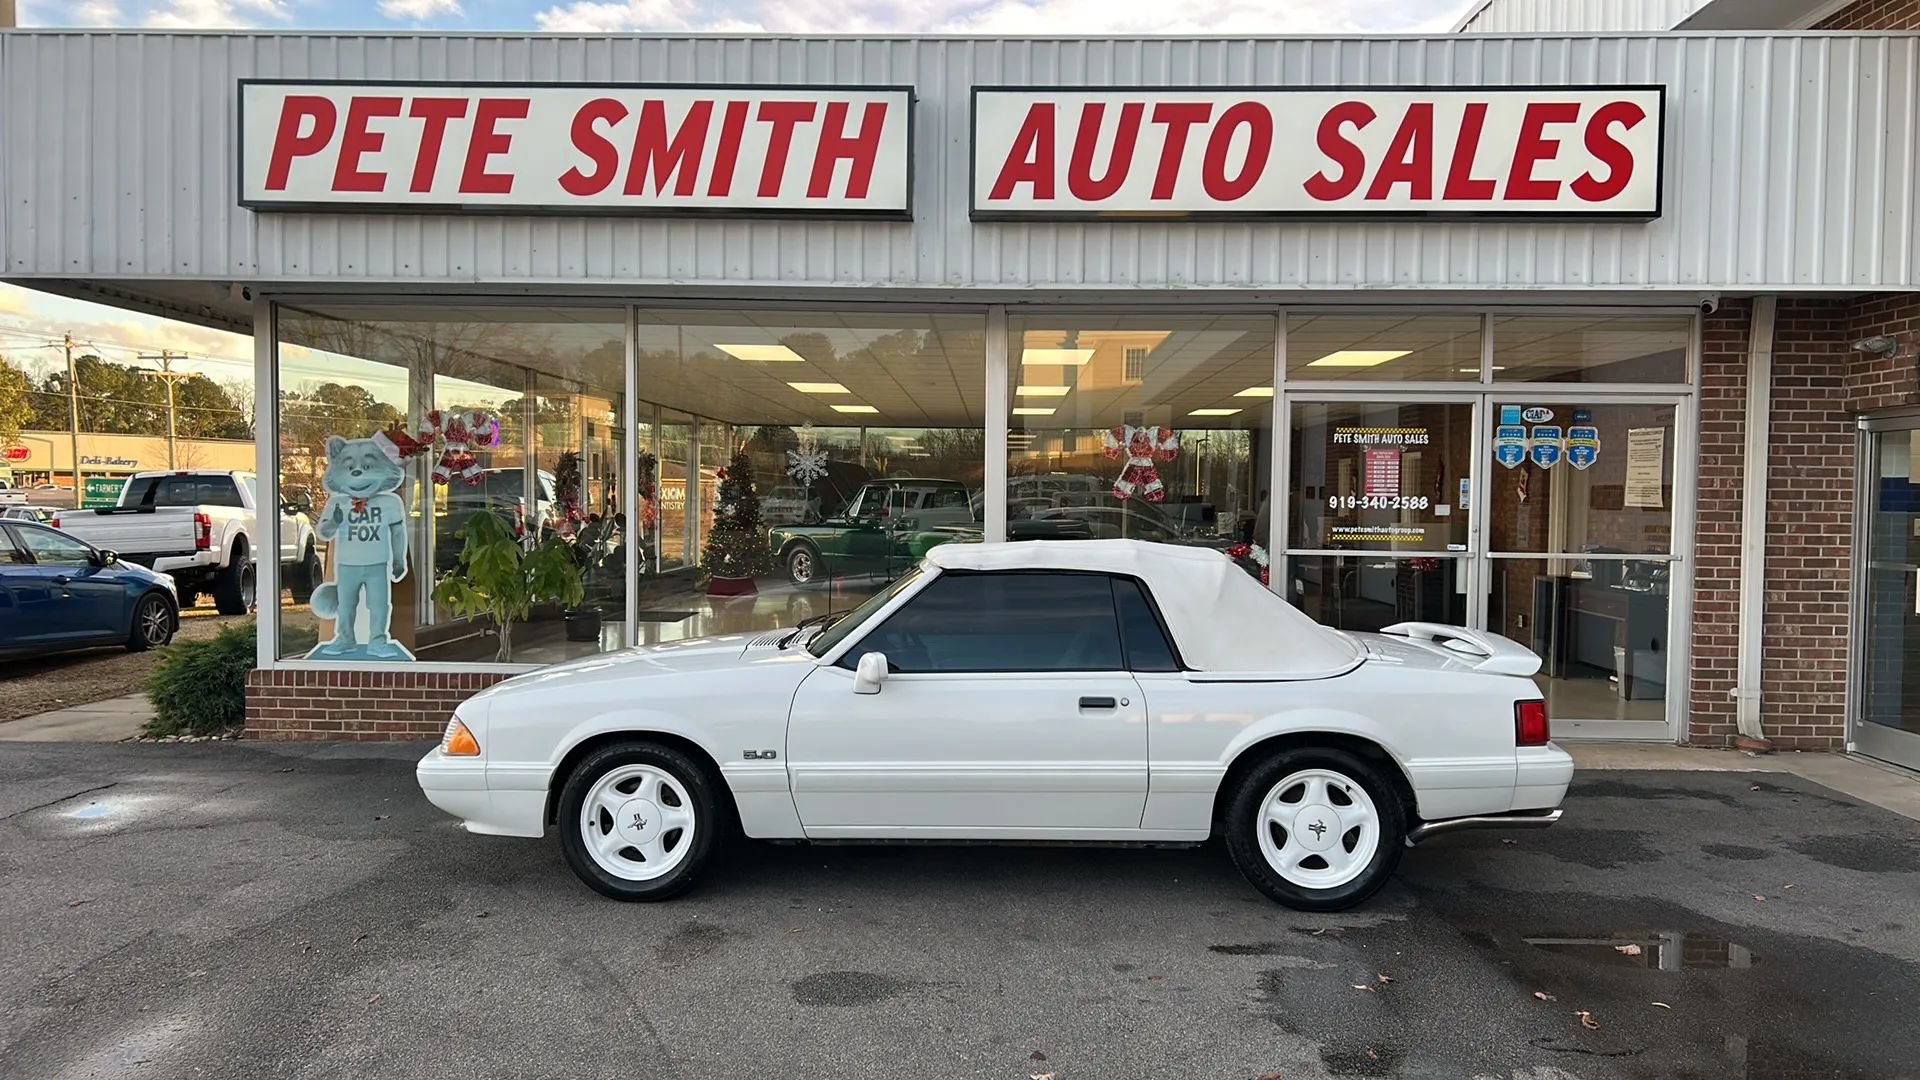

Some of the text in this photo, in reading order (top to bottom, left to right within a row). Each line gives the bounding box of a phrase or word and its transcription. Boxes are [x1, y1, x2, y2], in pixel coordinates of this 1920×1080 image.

[264, 95, 888, 199] PETE SMITH
[988, 101, 1647, 202] AUTO SALES
[1333, 433, 1429, 445] PETE SMITH AUTO SALES
[80, 456, 138, 468] Deli-Bakery
[661, 488, 686, 500] XIOM
[661, 501, 686, 510] NTISTRY
[1329, 496, 1429, 510] 919-340-2588
[348, 507, 382, 524] CAR
[348, 525, 381, 542] FOX
[1332, 526, 1425, 534] www.petesmithautogroup.com
[743, 750, 776, 760] 5.0
